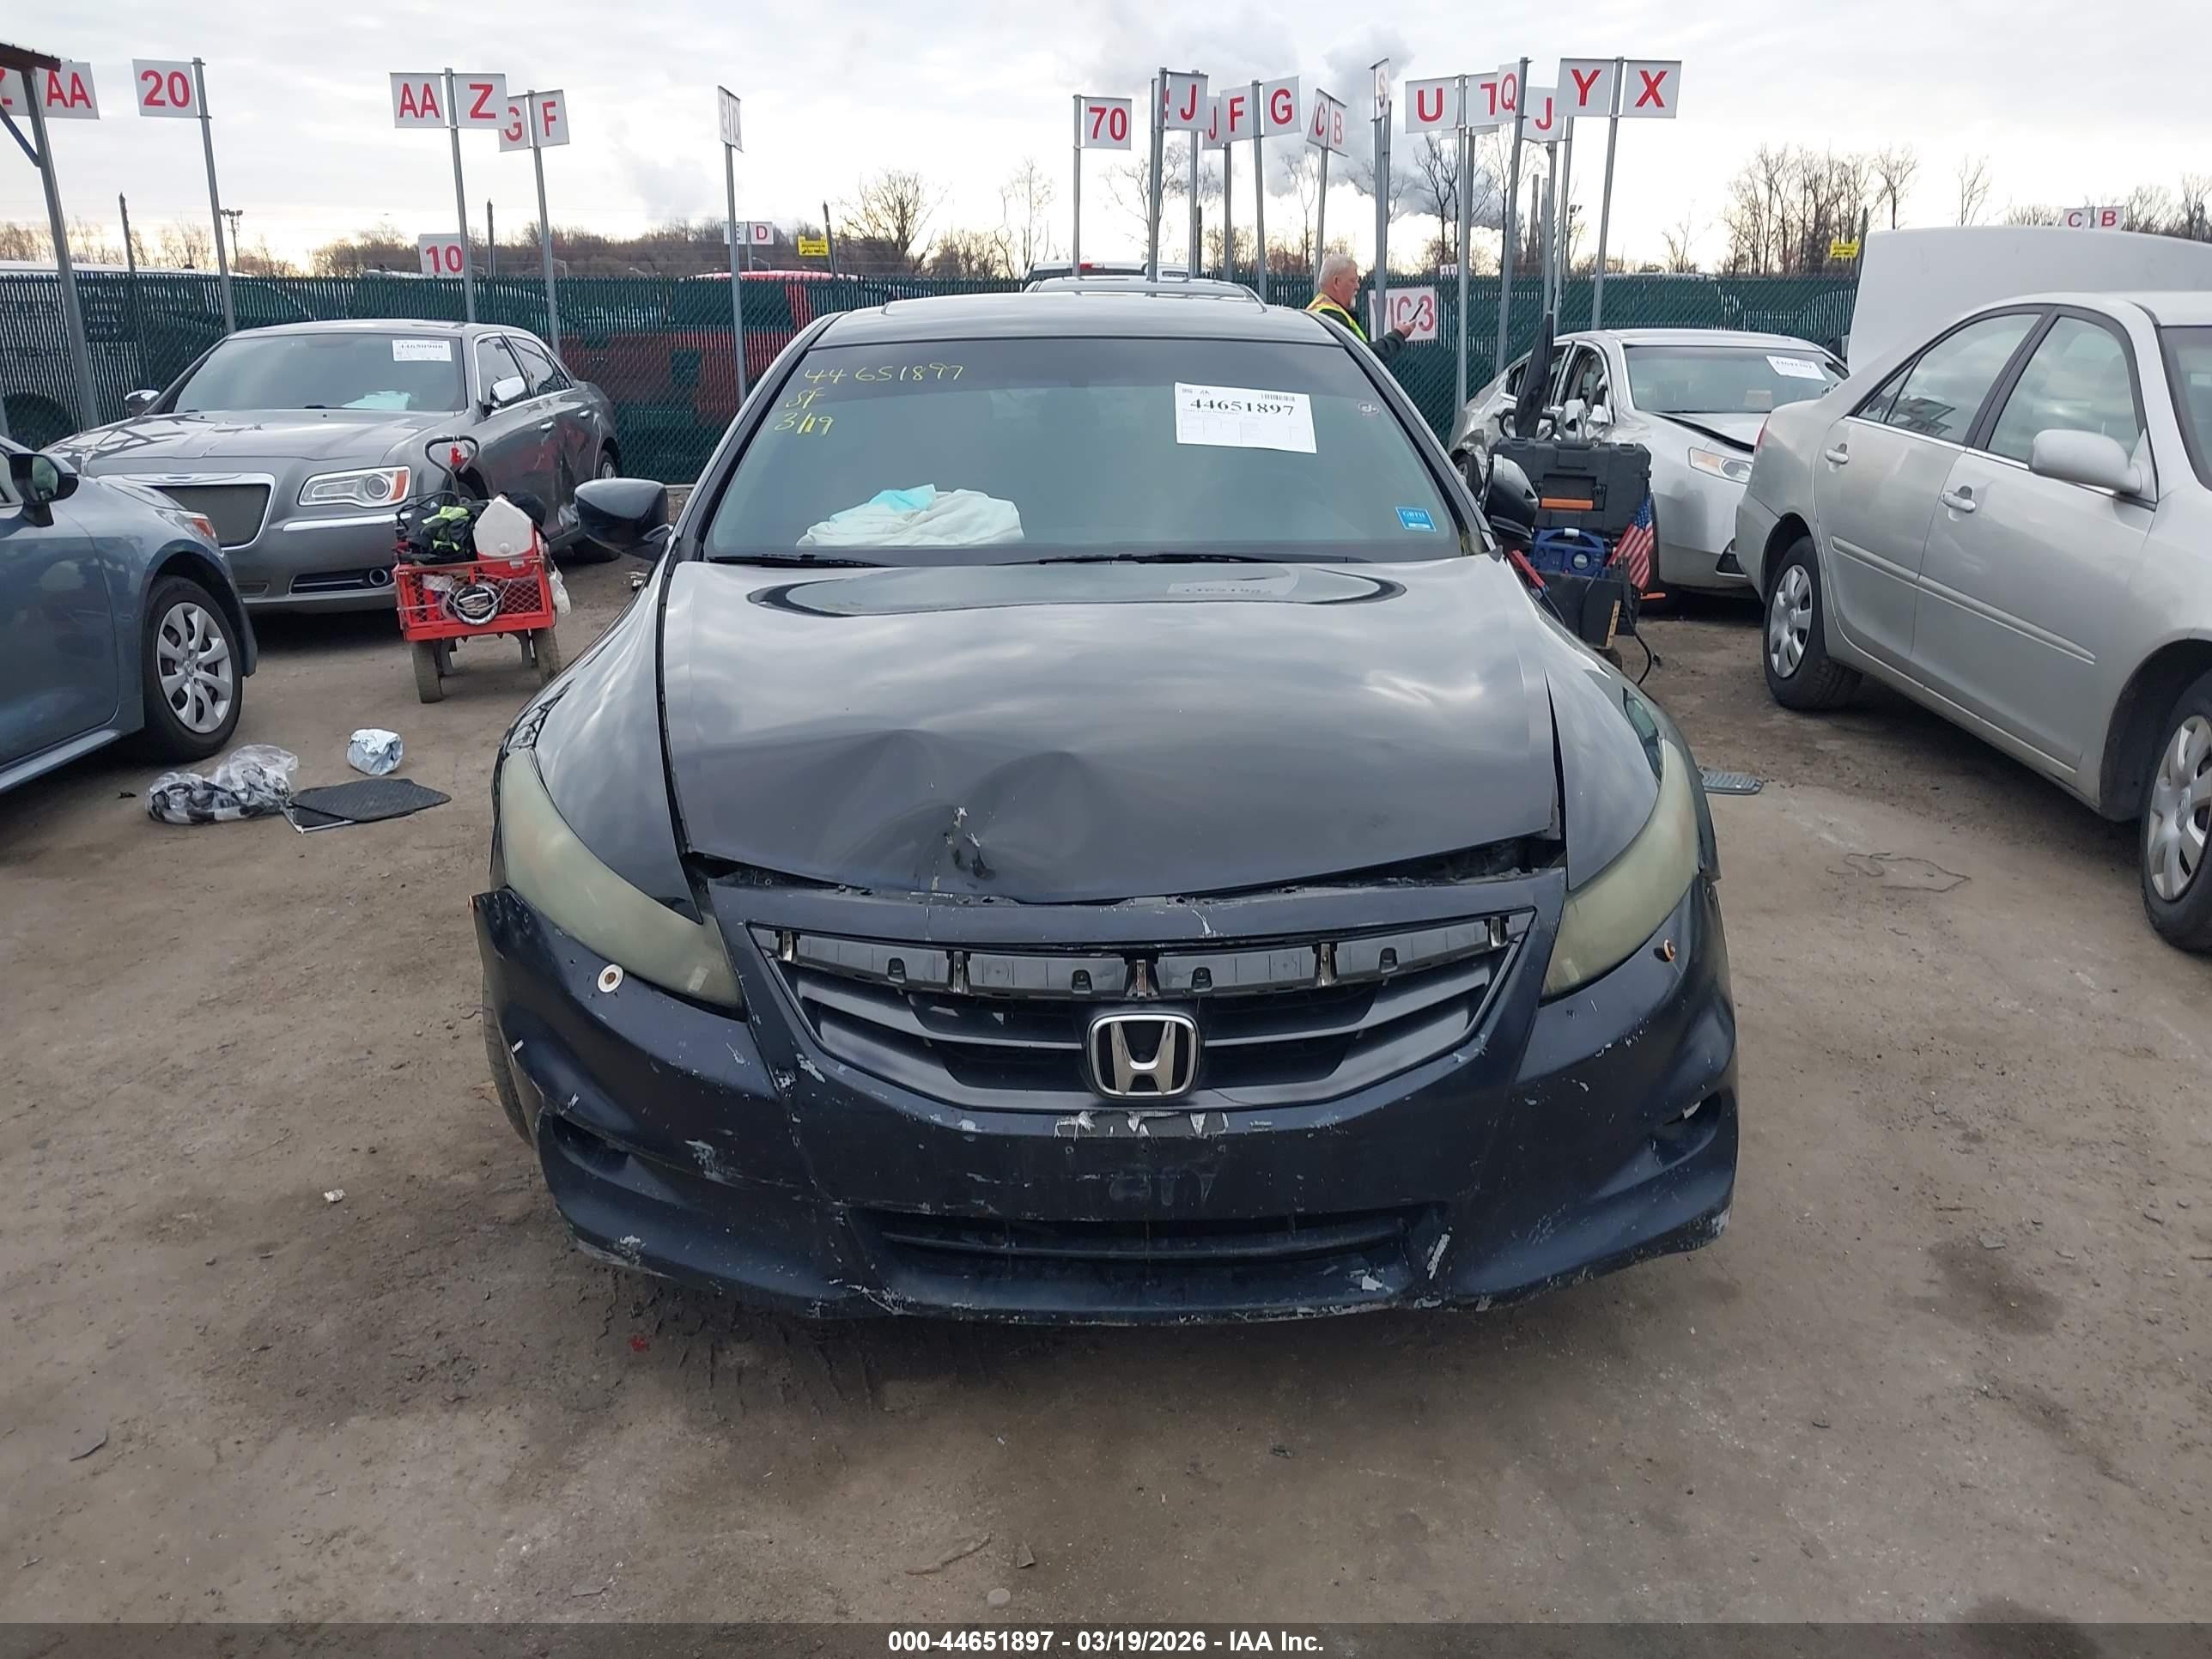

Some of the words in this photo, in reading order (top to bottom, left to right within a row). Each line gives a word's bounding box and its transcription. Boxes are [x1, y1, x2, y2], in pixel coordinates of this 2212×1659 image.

[46, 67, 92, 109] AA
[141, 70, 191, 108] 20
[399, 82, 441, 118] AA
[469, 83, 496, 119] Z
[1180, 84, 1197, 121] J
[1417, 88, 1443, 122] U
[1500, 73, 1517, 112] Q
[1571, 69, 1602, 106] Y
[1634, 70, 1668, 108] X
[504, 106, 523, 142] G
[542, 100, 556, 137] F
[1089, 106, 1127, 142] 70
[1208, 106, 1218, 141] J
[1229, 96, 1245, 132] F
[1270, 88, 1293, 125] G
[1315, 104, 1326, 137] C
[1535, 97, 1553, 131] J
[1334, 111, 1342, 145] B
[756, 225, 769, 240] D
[2068, 211, 2083, 228] C
[2101, 210, 2117, 227] B
[425, 245, 463, 274] 10
[1189, 398, 1295, 416] 44651897
